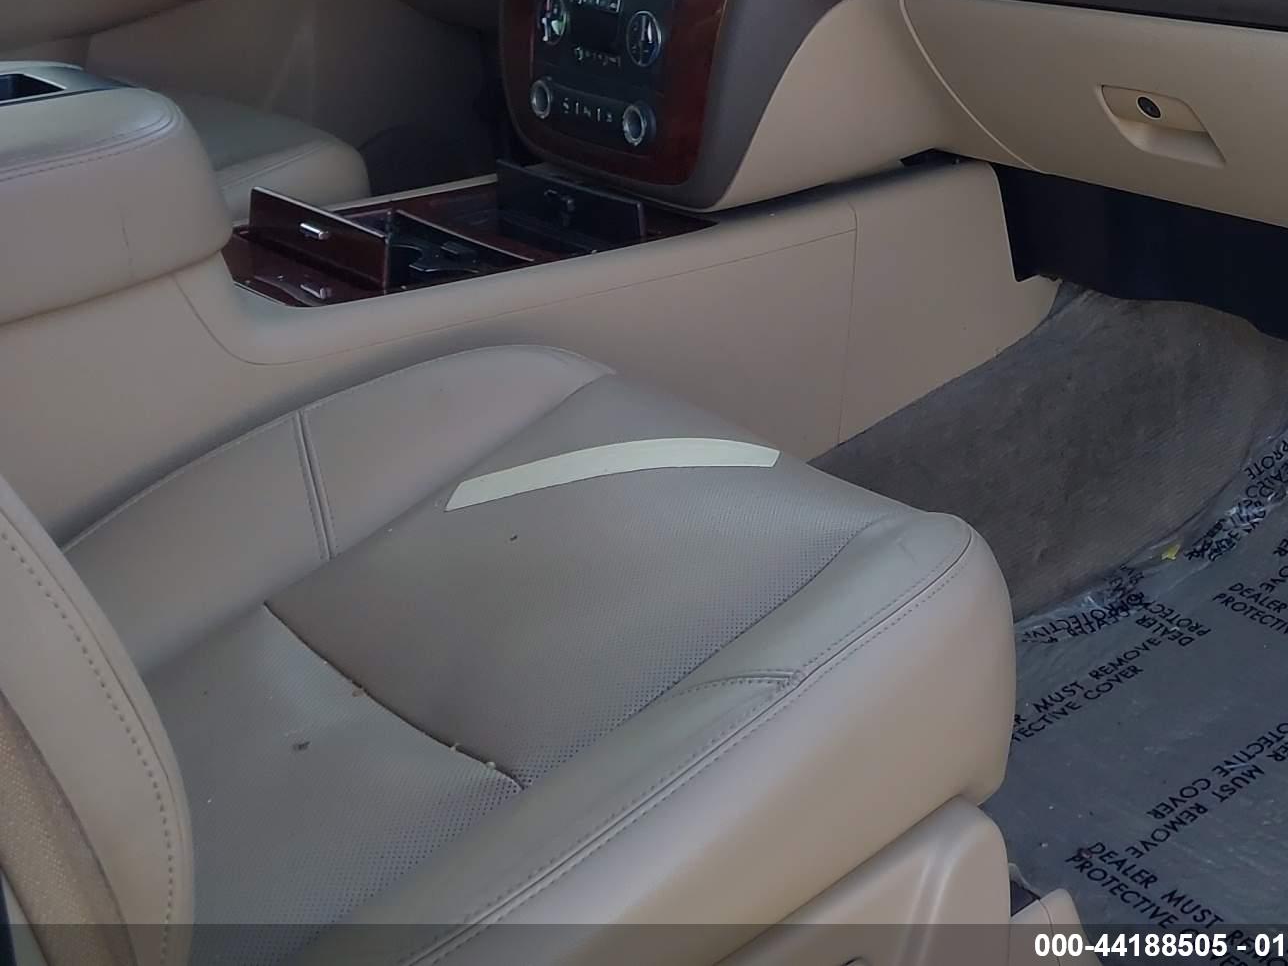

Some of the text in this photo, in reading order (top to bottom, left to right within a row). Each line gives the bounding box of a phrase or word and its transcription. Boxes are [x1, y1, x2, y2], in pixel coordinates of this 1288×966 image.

[1228, 581, 1288, 614] DEALER
[1136, 614, 1196, 648] DEALER
[1032, 635, 1162, 714] MUST REMOVE
[1083, 664, 1144, 701] COVER
[1146, 778, 1211, 820] COVER
[1211, 764, 1265, 803] MUST
[1125, 802, 1208, 859] REMOVE
[1065, 854, 1178, 930] PROTECTIVE
[1086, 841, 1158, 890] DEALER
[1161, 888, 1224, 929] MUST
